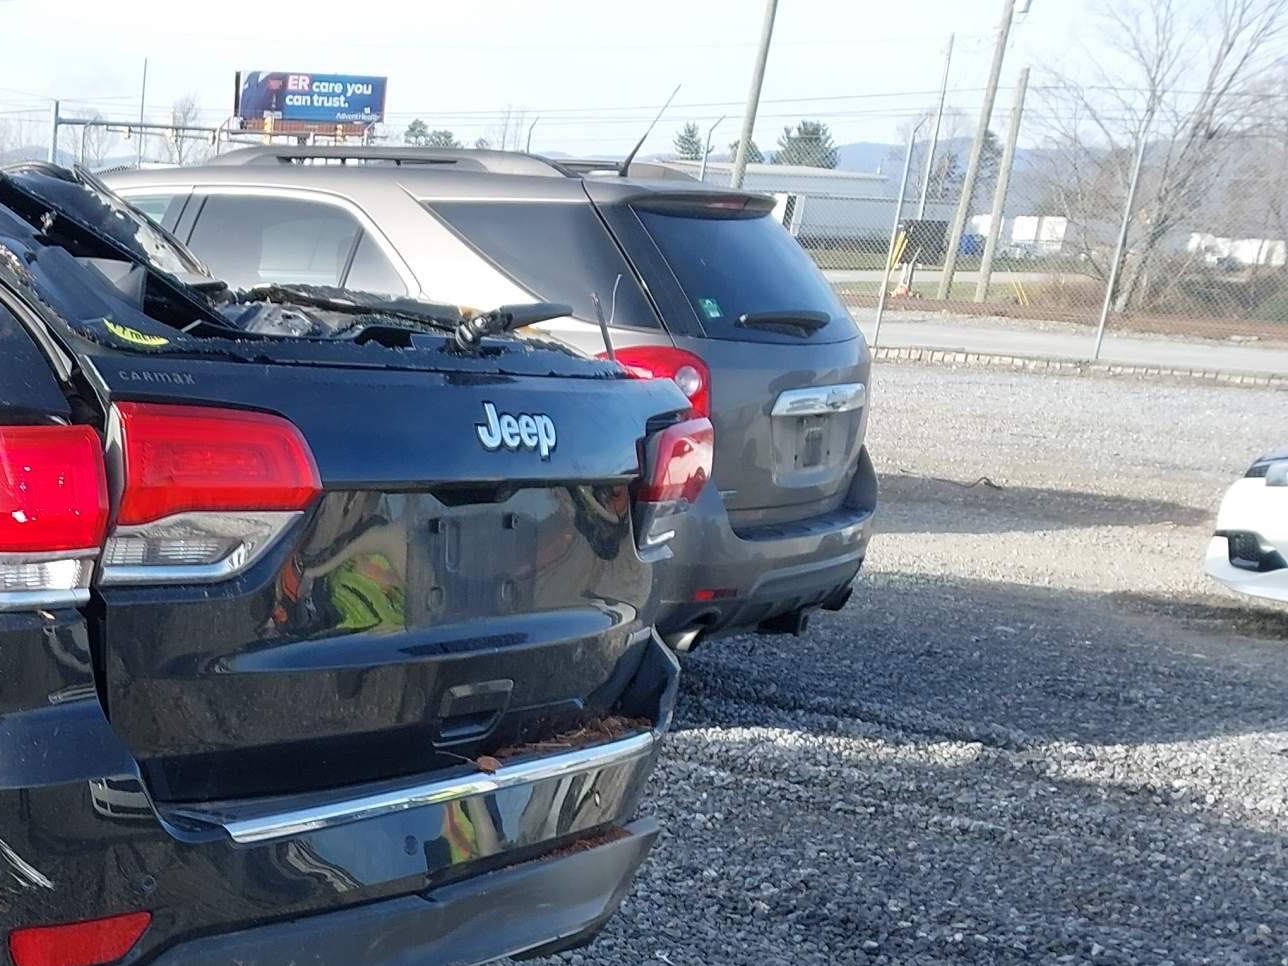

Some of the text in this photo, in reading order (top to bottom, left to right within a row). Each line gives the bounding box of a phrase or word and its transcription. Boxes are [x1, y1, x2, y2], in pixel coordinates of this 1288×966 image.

[287, 74, 372, 97] ER care you
[285, 93, 349, 108] can trust.
[476, 401, 557, 460] Jeep
